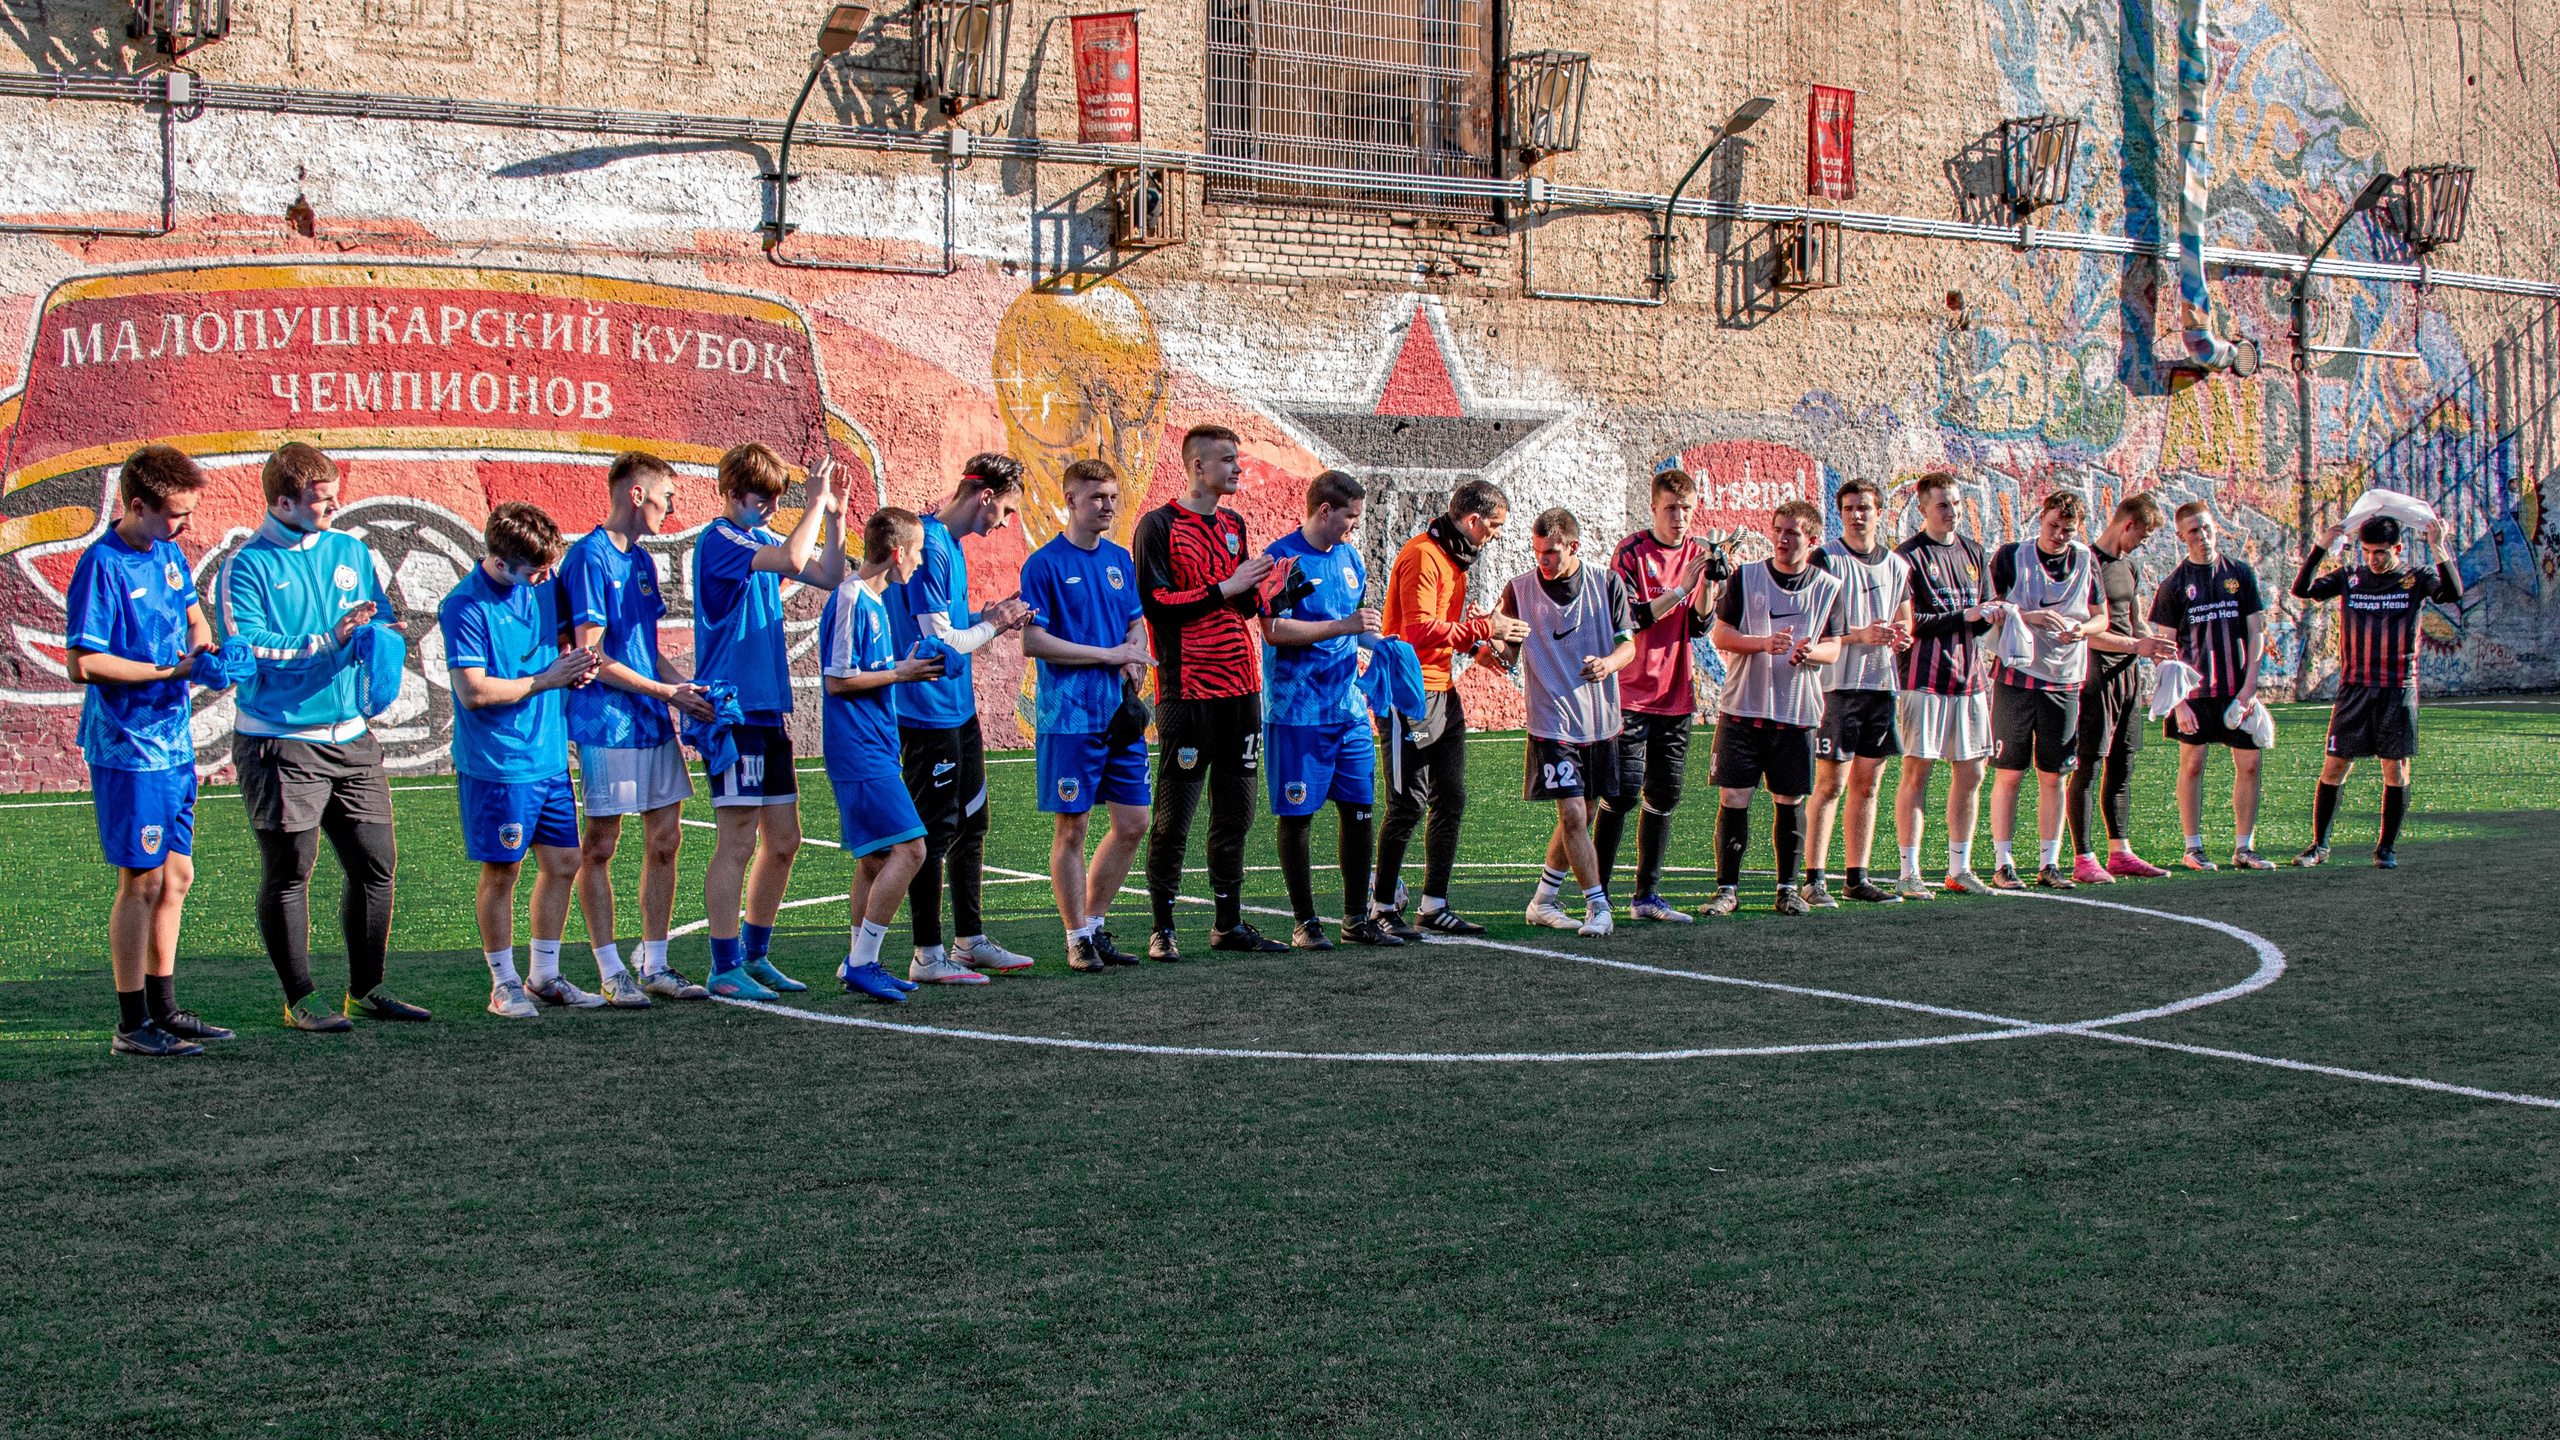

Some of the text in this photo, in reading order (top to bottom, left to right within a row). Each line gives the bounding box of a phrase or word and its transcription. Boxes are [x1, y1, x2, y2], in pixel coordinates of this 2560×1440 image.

[61, 301, 793, 384] МАЛОПУШКАРСКИЙ КУБОК
[272, 372, 614, 419] ЧЕМПИОНОВ
[1694, 468, 1806, 511] Arsenal
[1814, 737, 1832, 755] 13
[2328, 734, 2337, 752] 1
[1543, 760, 1578, 789] 22
